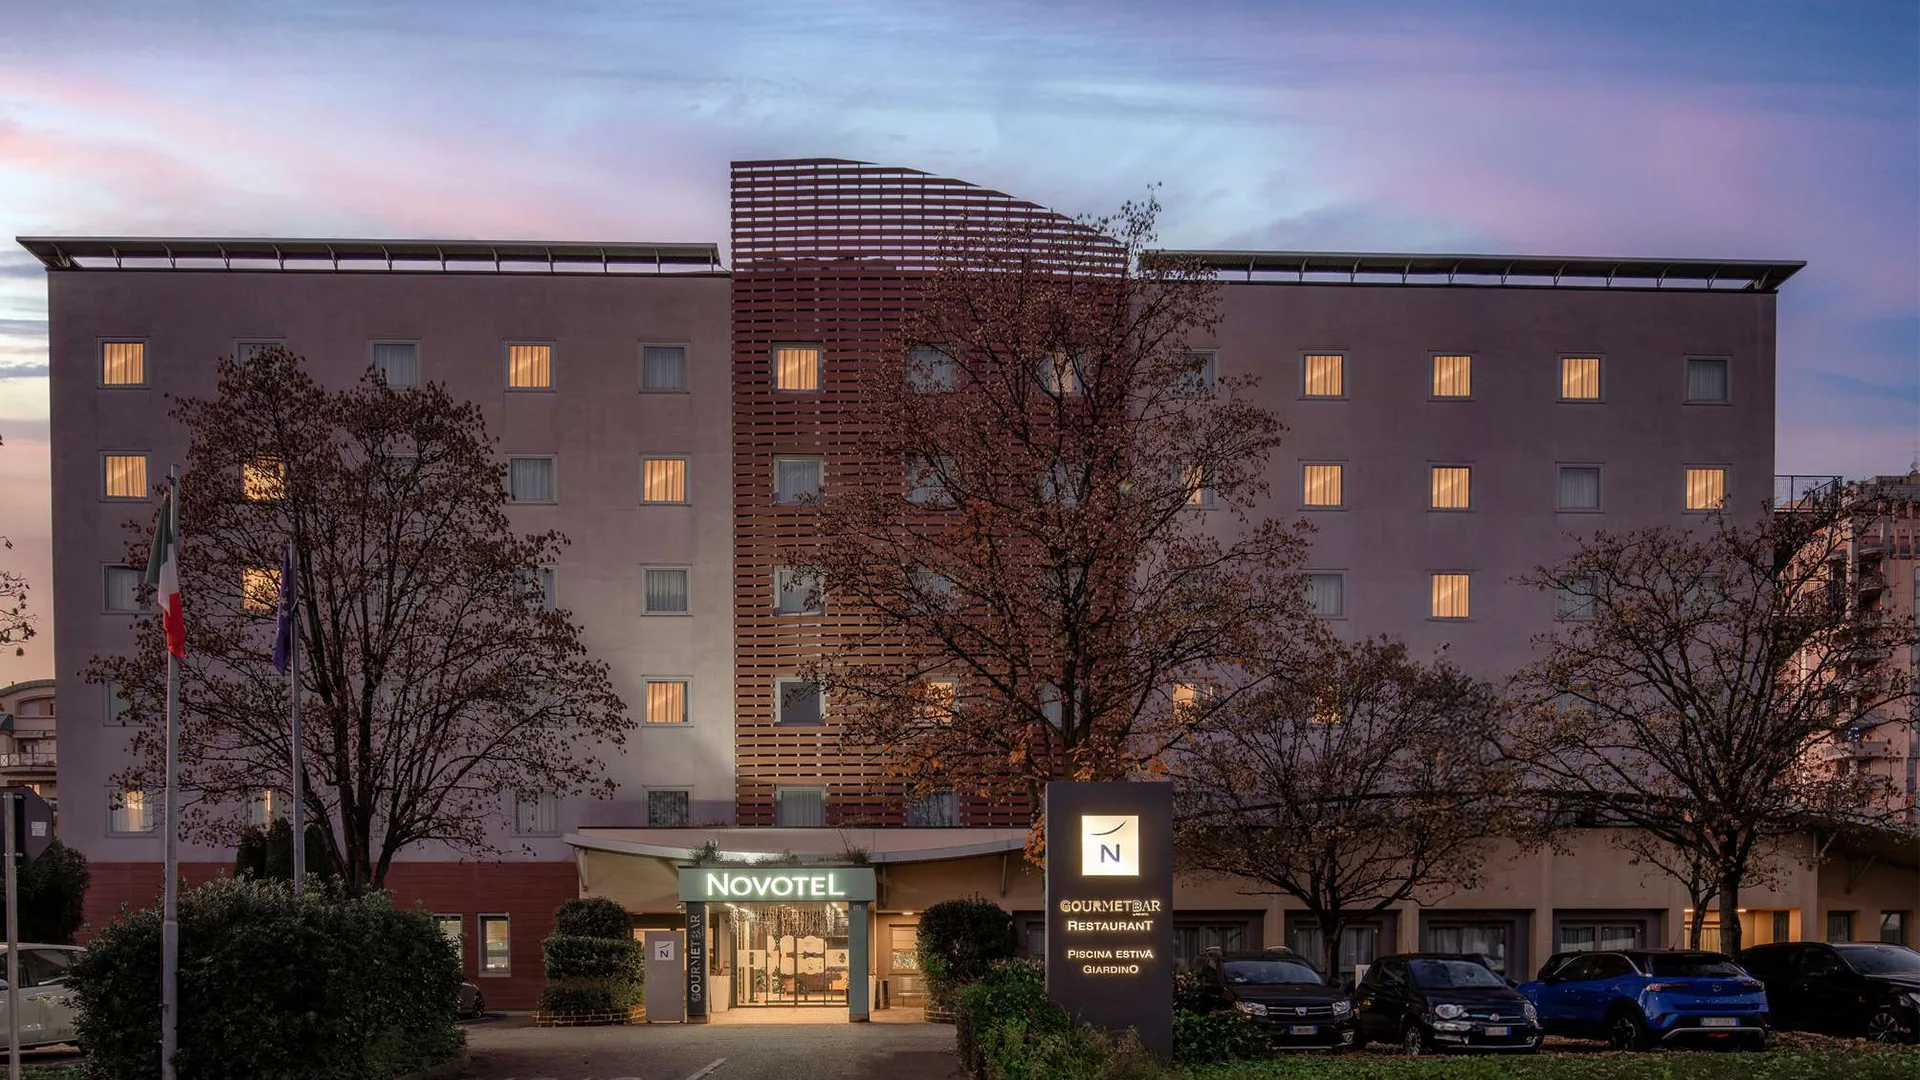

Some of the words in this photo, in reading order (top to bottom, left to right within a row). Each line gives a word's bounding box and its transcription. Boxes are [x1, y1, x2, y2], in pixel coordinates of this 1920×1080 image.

[1101, 844, 1120, 863] N
[707, 873, 845, 896] NOVOTEL
[1060, 899, 1161, 913] GOURMETBAR
[1067, 920, 1153, 931] RESTAURANT
[1067, 950, 1112, 959] PISCINA
[1116, 950, 1154, 959] ESTIVA
[1083, 964, 1139, 974] GIARDINO
